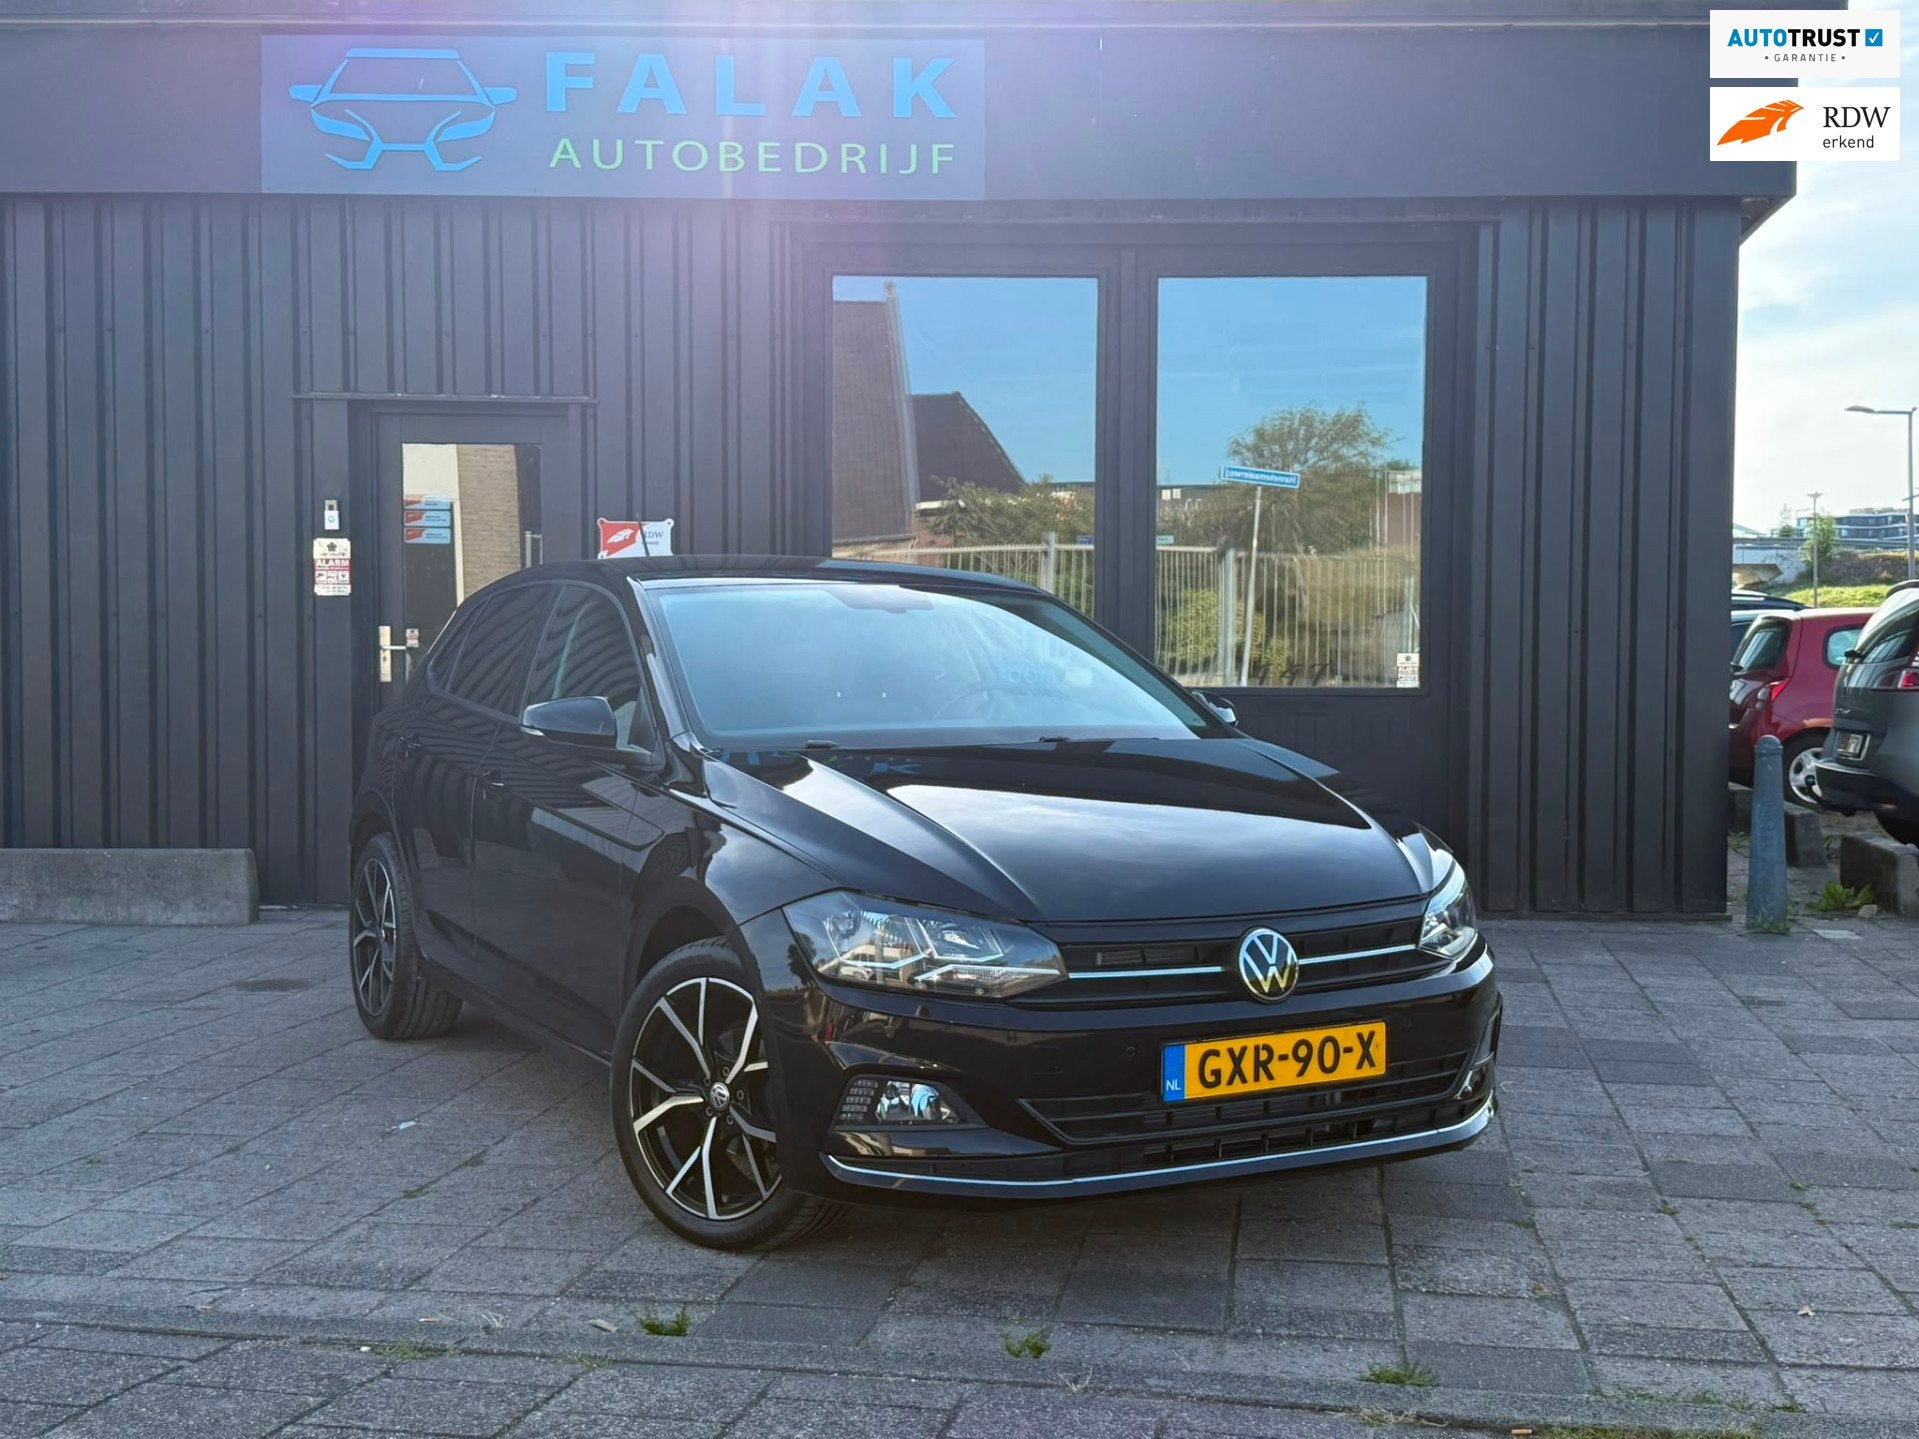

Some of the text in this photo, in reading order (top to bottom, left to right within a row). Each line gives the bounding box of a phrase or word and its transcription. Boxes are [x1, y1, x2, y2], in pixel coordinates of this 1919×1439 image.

[546, 51, 957, 118] FALAK
[549, 137, 955, 174] AUTOBEDRIJF
[1198, 1030, 1376, 1089] GXR-90-X
[1165, 1079, 1182, 1091] NL
